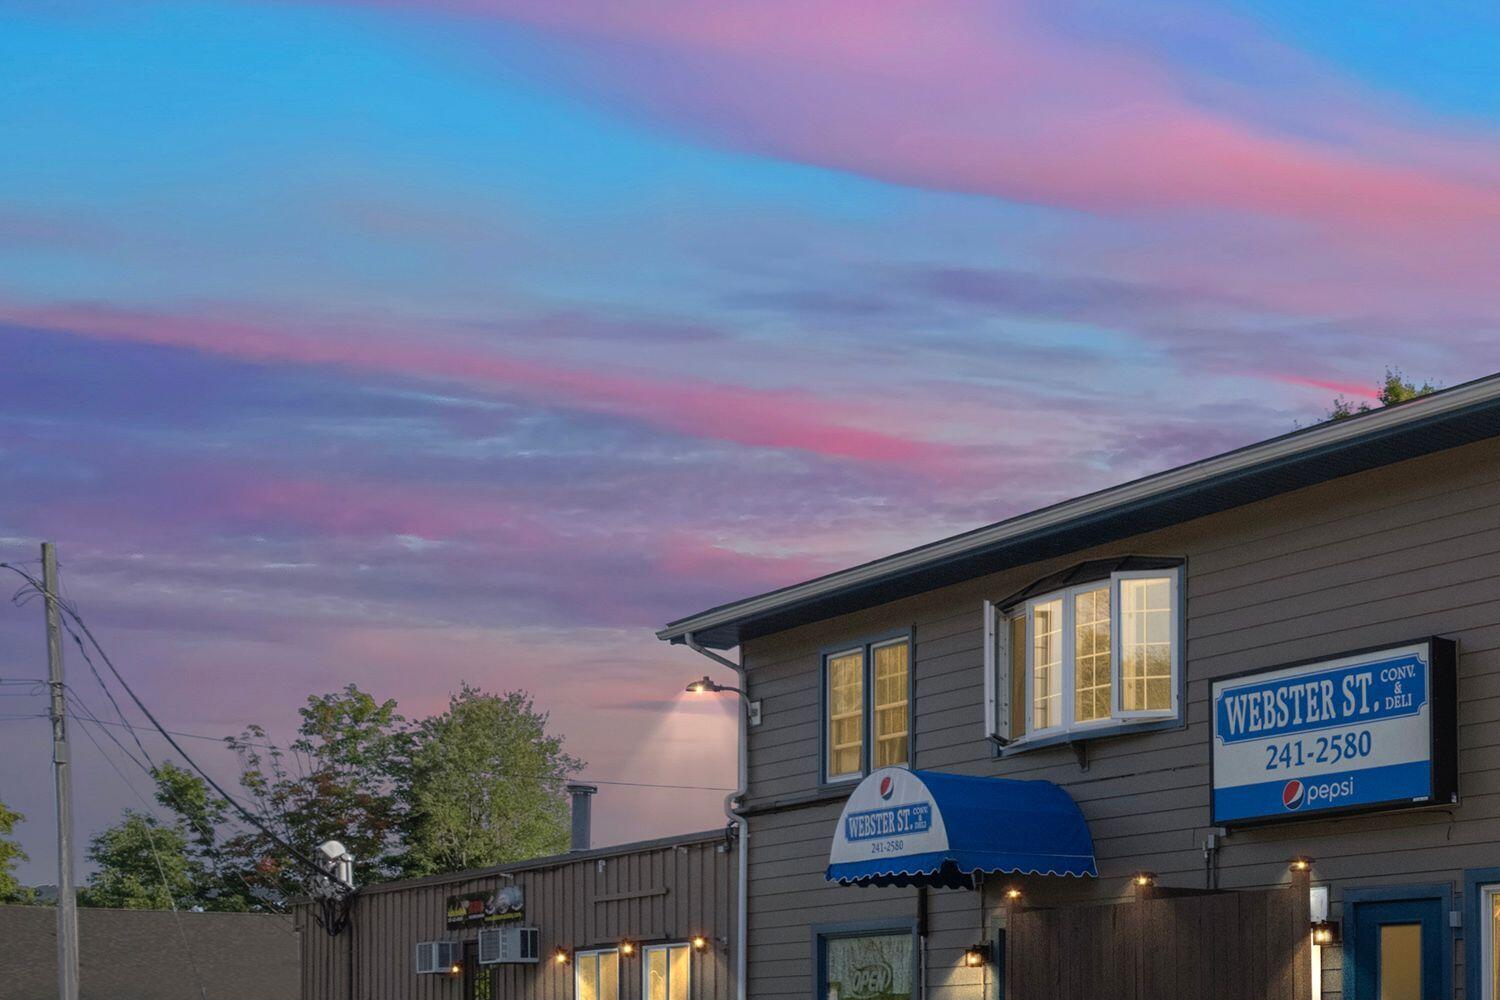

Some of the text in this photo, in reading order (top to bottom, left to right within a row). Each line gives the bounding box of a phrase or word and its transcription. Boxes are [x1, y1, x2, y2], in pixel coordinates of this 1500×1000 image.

[1380, 664, 1416, 683] CONV.
[1393, 681, 1403, 694] &
[1225, 672, 1380, 735] WEBSTER ST.
[1385, 693, 1413, 711] DELI
[1265, 730, 1372, 770] 241-2580
[1307, 776, 1354, 805] pepsi
[849, 808, 914, 839] WEBSTER ST.
[871, 840, 904, 854] 241-2580
[853, 968, 887, 993] OPEN
